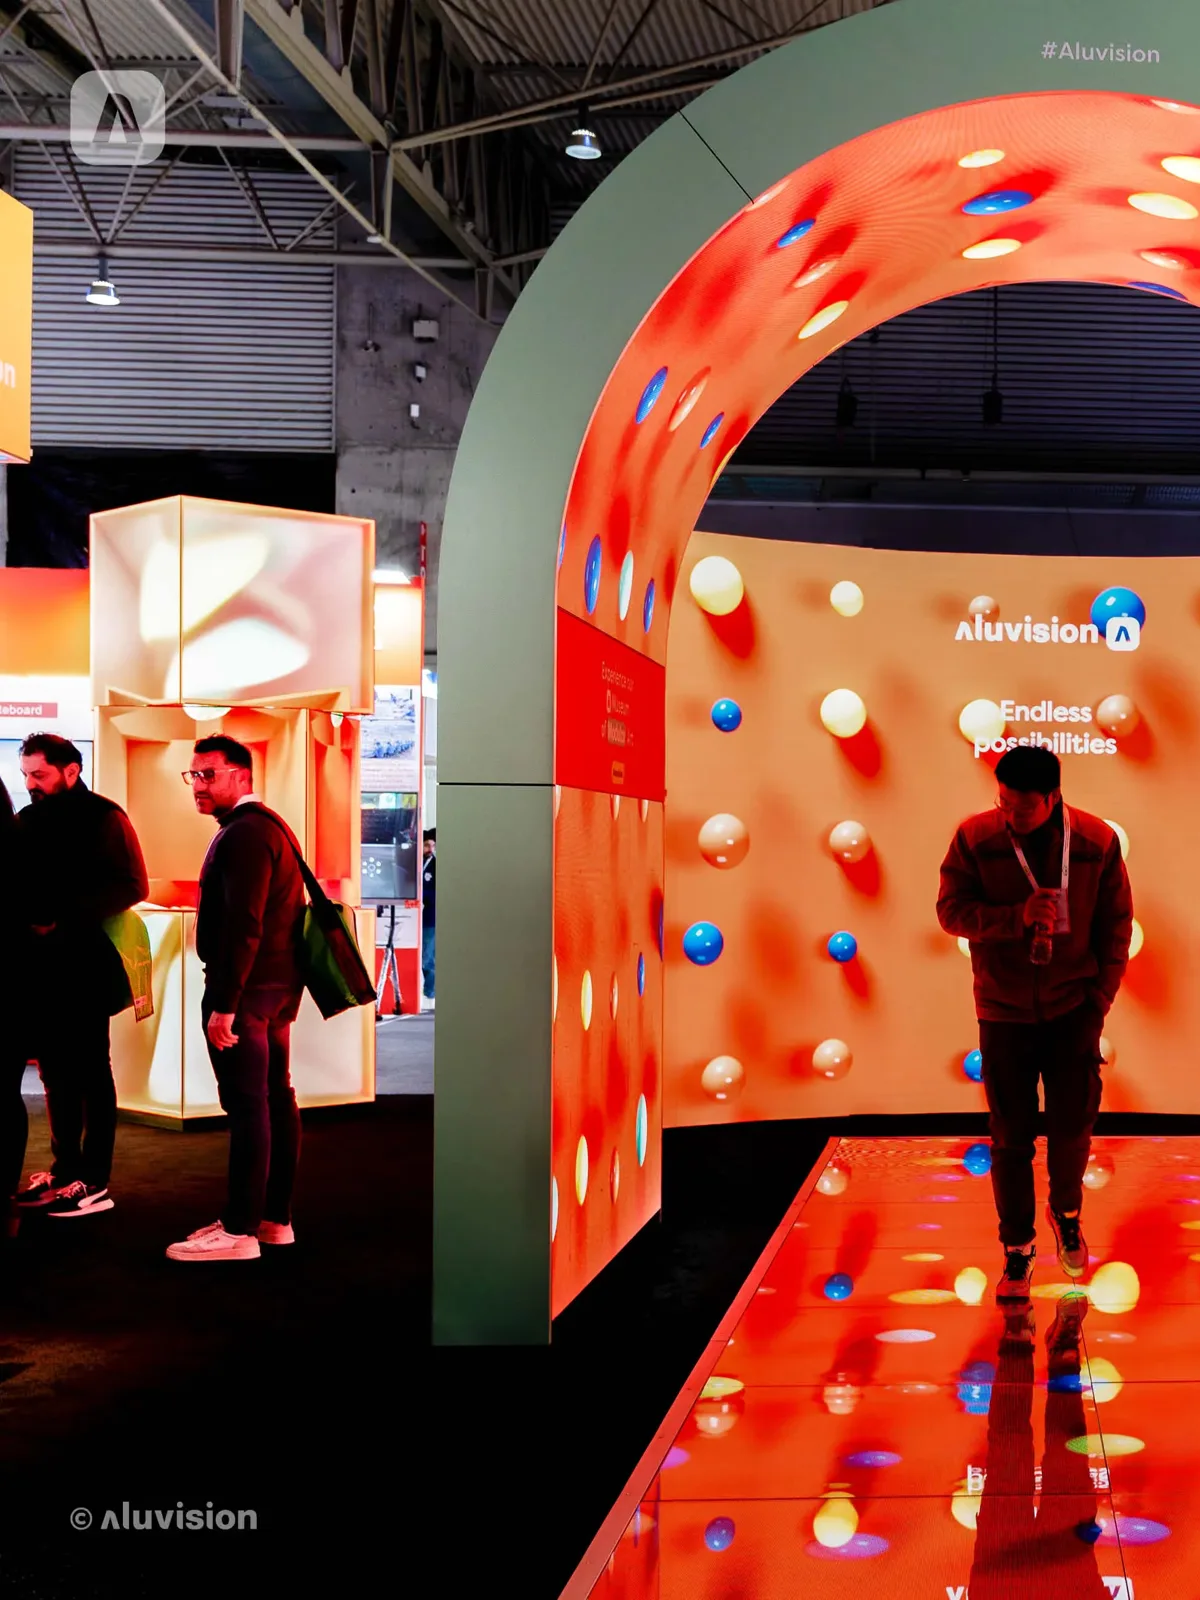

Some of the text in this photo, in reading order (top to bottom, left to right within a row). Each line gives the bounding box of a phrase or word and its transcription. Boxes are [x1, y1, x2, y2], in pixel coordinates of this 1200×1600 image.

[1041, 41, 1160, 63] #Aluvision
[1000, 700, 1092, 723] Endless
[974, 731, 1117, 758] possibilities
